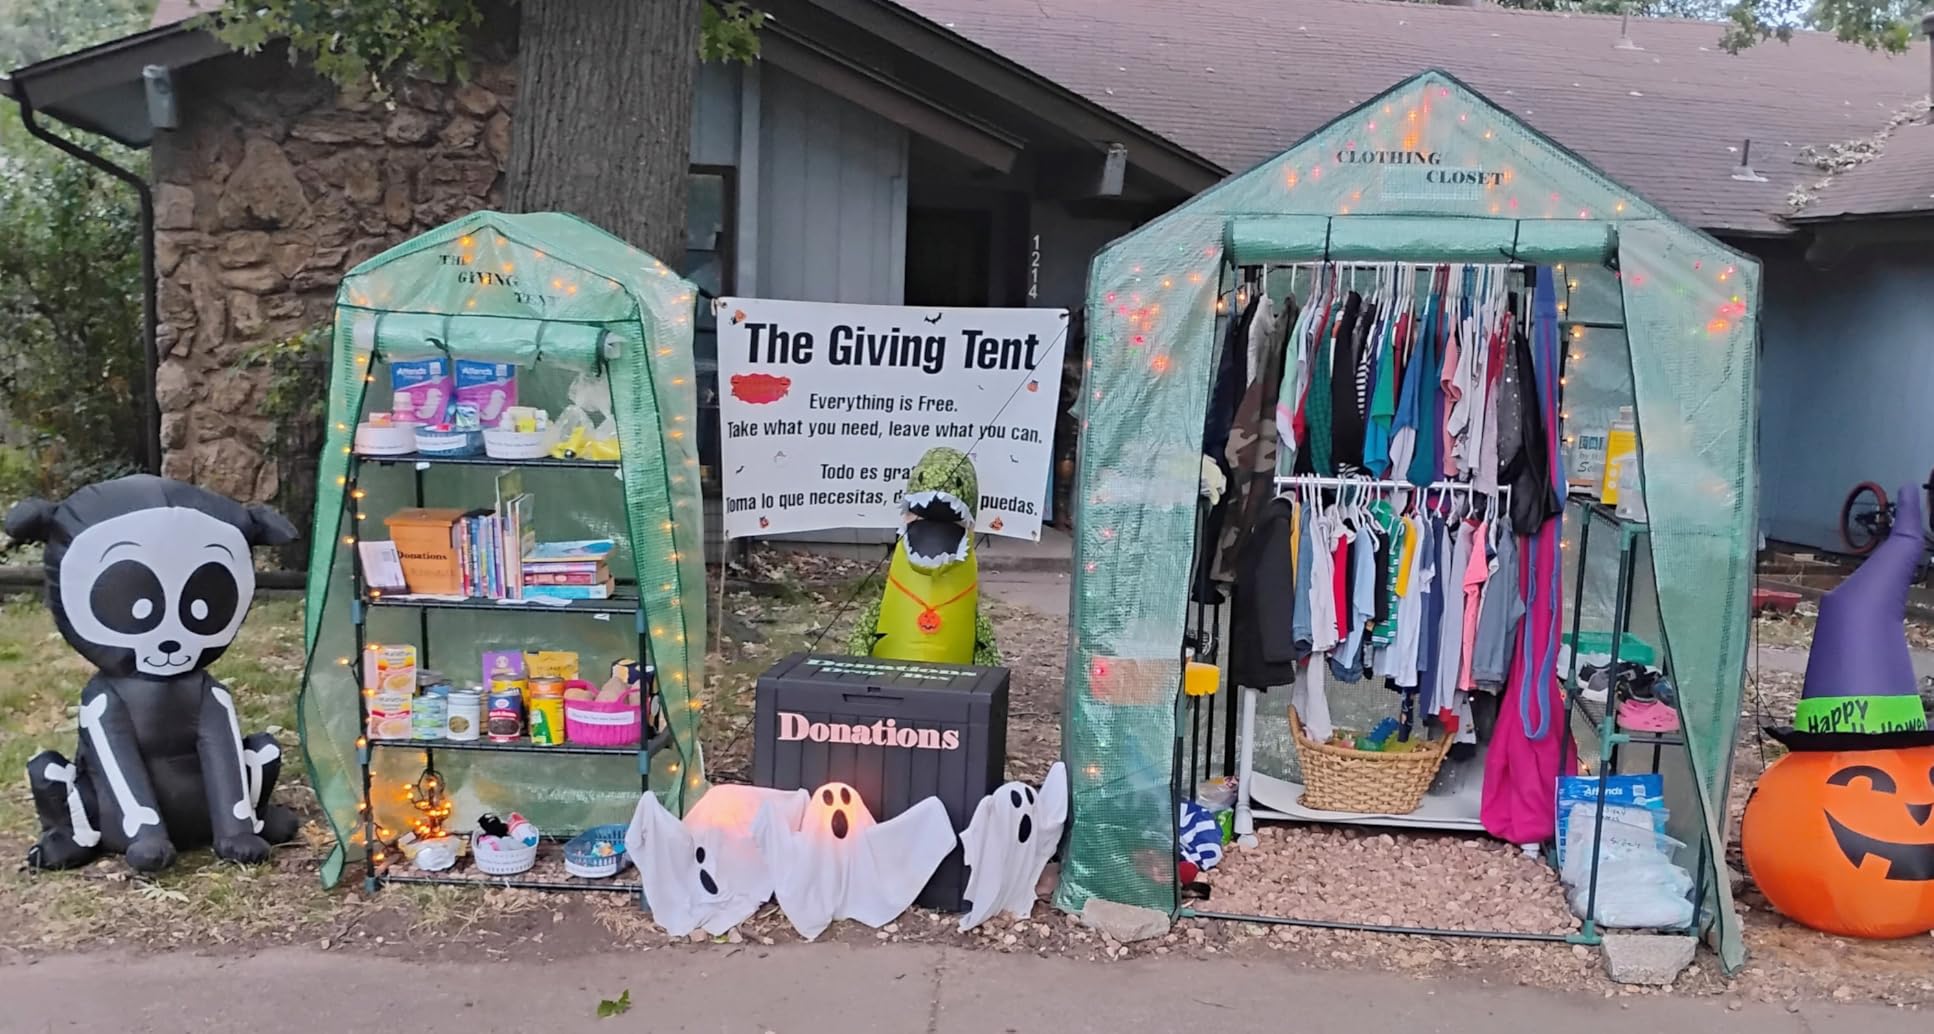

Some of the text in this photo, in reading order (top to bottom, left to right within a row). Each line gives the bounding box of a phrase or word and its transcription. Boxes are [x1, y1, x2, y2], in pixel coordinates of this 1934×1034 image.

[1336, 150, 1441, 165] CLOTHING
[1426, 170, 1504, 185] CLOSET
[1028, 234, 1040, 299] 1214
[458, 271, 519, 287] GIVING
[744, 323, 1039, 375] The Giving Tent
[809, 393, 958, 413] Everything is Free.
[727, 419, 1043, 444] Take what you need, leave what you can.
[820, 464, 915, 482] Todo es gra
[761, 492, 774, 509] lo
[779, 493, 805, 510] que
[809, 489, 888, 507] necesitas,
[980, 495, 1038, 516] puedas.
[397, 550, 448, 560] Donations
[806, 659, 977, 677] Donations
[1808, 699, 1869, 733] Happy
[777, 712, 960, 750] Donations
[1584, 786, 1623, 796] Attnds
